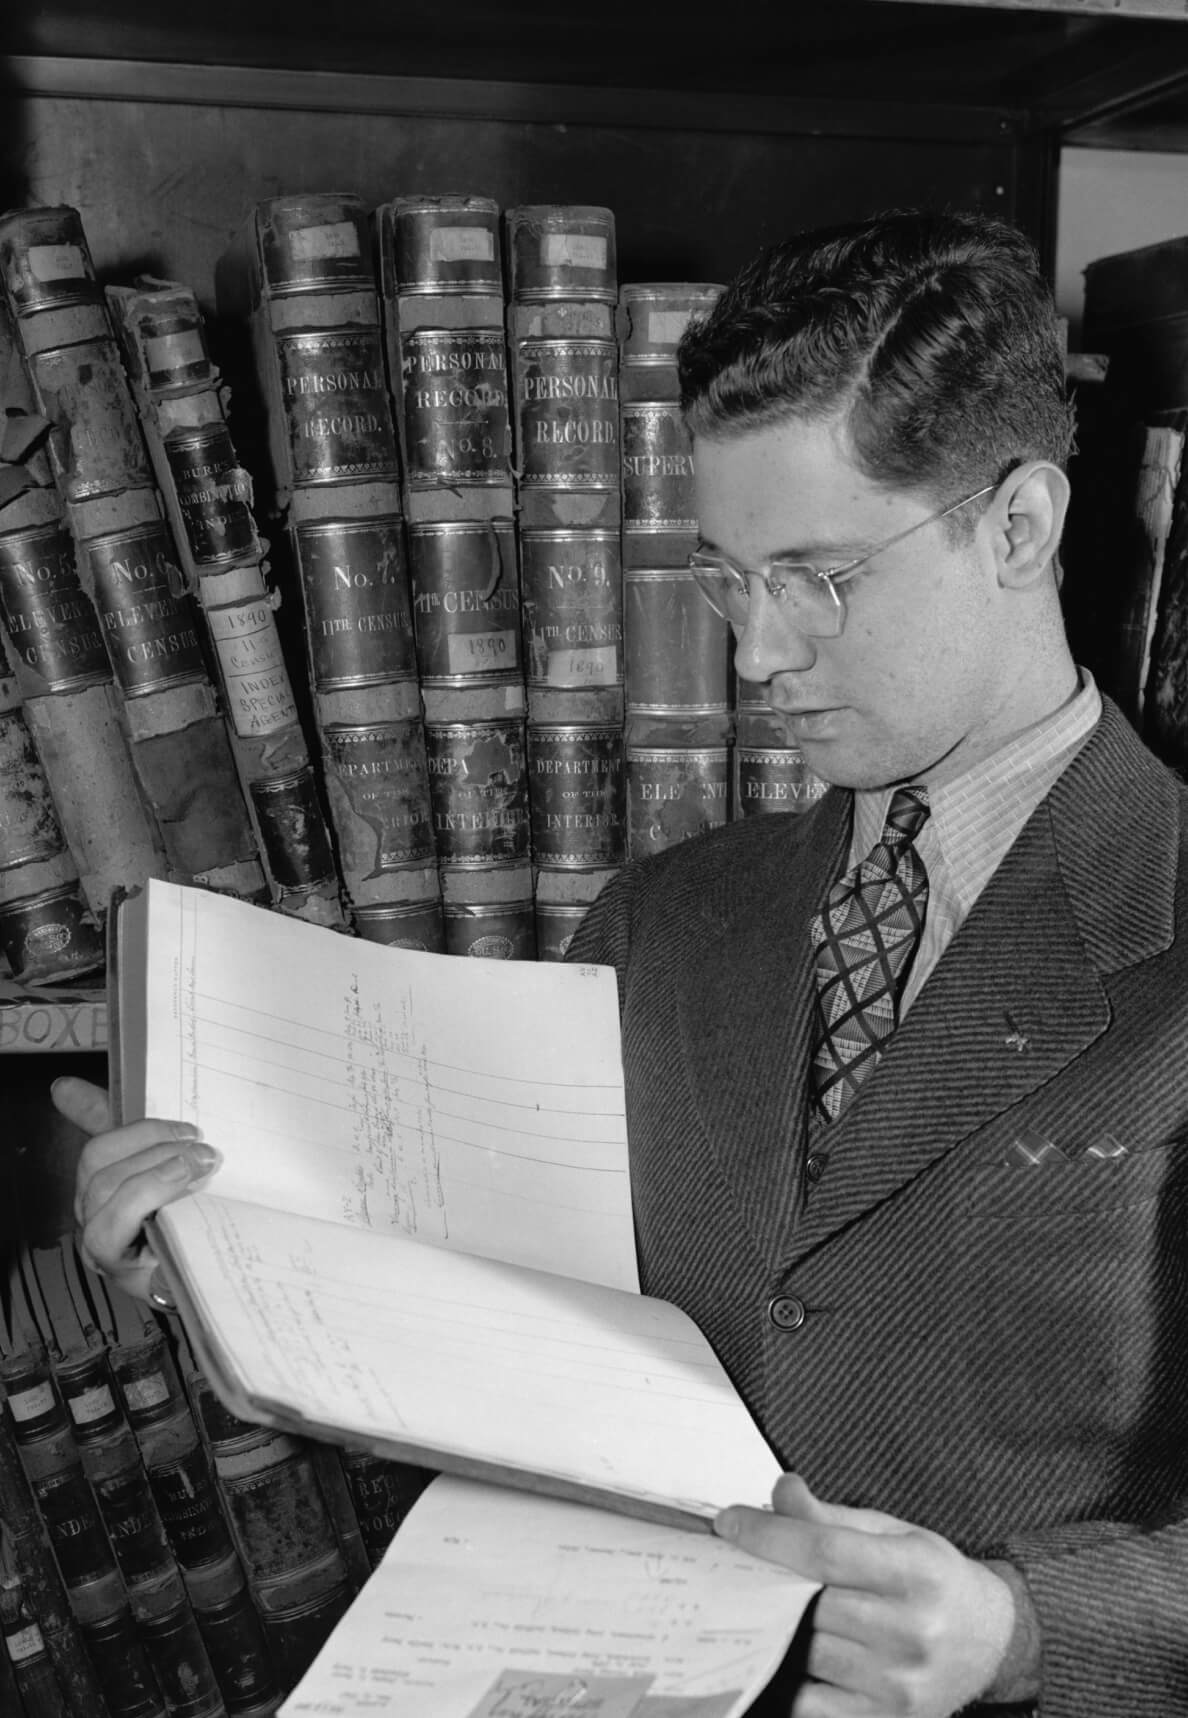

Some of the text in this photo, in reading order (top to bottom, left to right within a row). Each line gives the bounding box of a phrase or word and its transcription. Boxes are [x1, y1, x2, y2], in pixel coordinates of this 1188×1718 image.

[406, 352, 505, 374] PERSONAL
[525, 375, 618, 400] PERSONAL
[623, 455, 696, 476] SUPERV
[111, 559, 154, 585] No.
[333, 565, 373, 590] No.
[0, 1007, 108, 1048] BOXE
